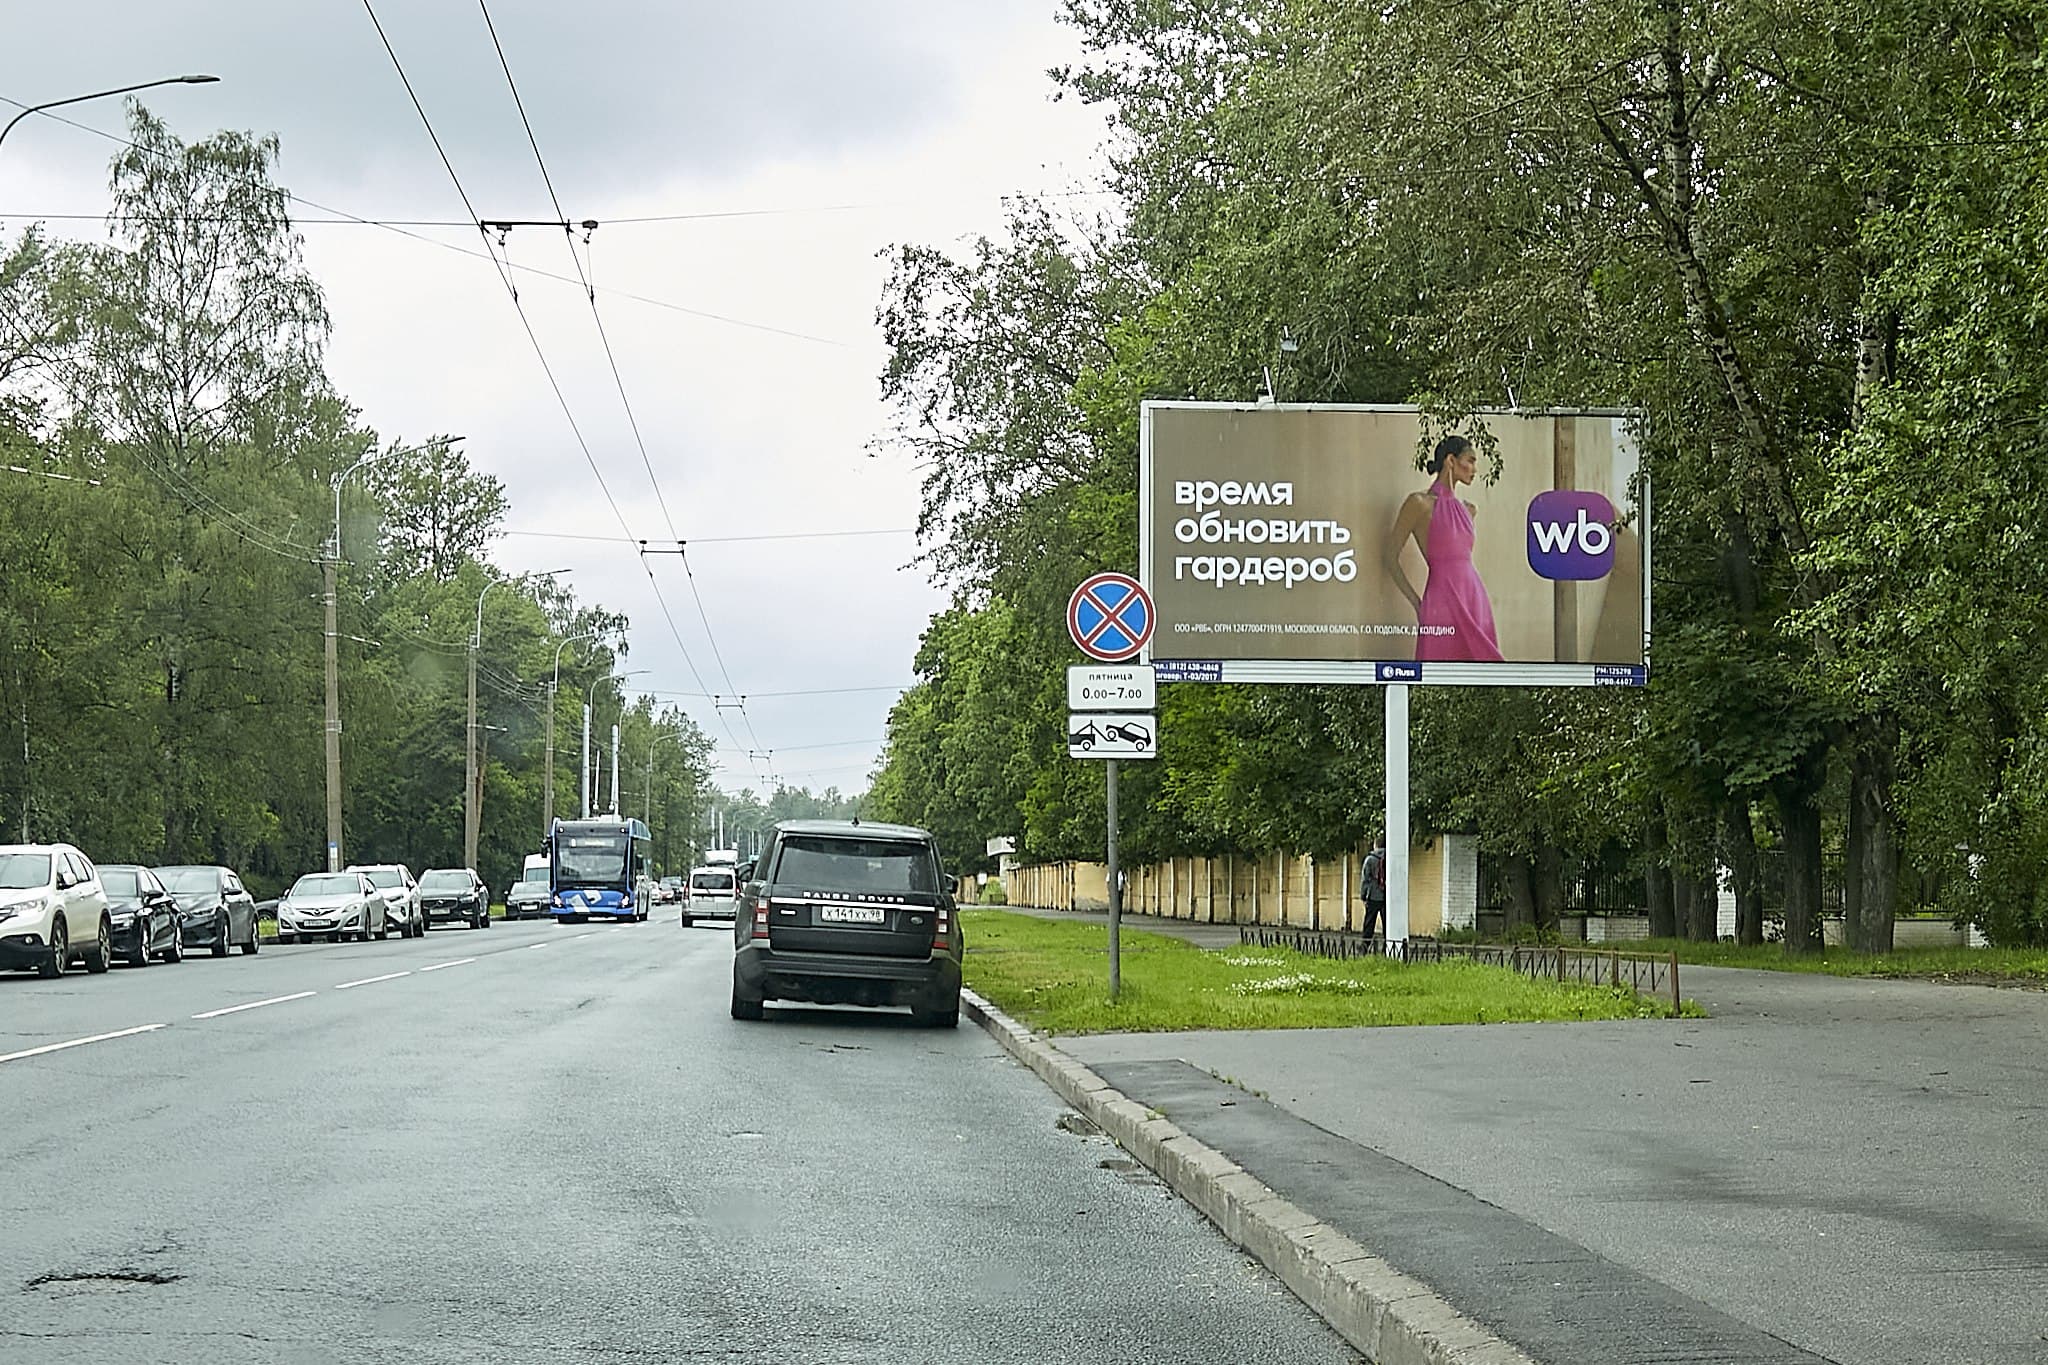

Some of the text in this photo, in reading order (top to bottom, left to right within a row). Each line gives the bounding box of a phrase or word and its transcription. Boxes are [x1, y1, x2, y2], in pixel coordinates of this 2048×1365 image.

[1175, 481, 1293, 512] время
[1174, 510, 1351, 544] обновить
[1532, 509, 1610, 555] wb
[1175, 550, 1357, 588] гардероб
[1174, 623, 1190, 633] ООО
[1214, 623, 1231, 633] ОГРН
[1284, 624, 1329, 634] МОСКОВСКАЯ
[1419, 625, 1456, 636] КОЛЕДИНО
[1088, 673, 1133, 681] пятница
[1395, 668, 1415, 676] Russ
[858, 894, 905, 903] ROVER
